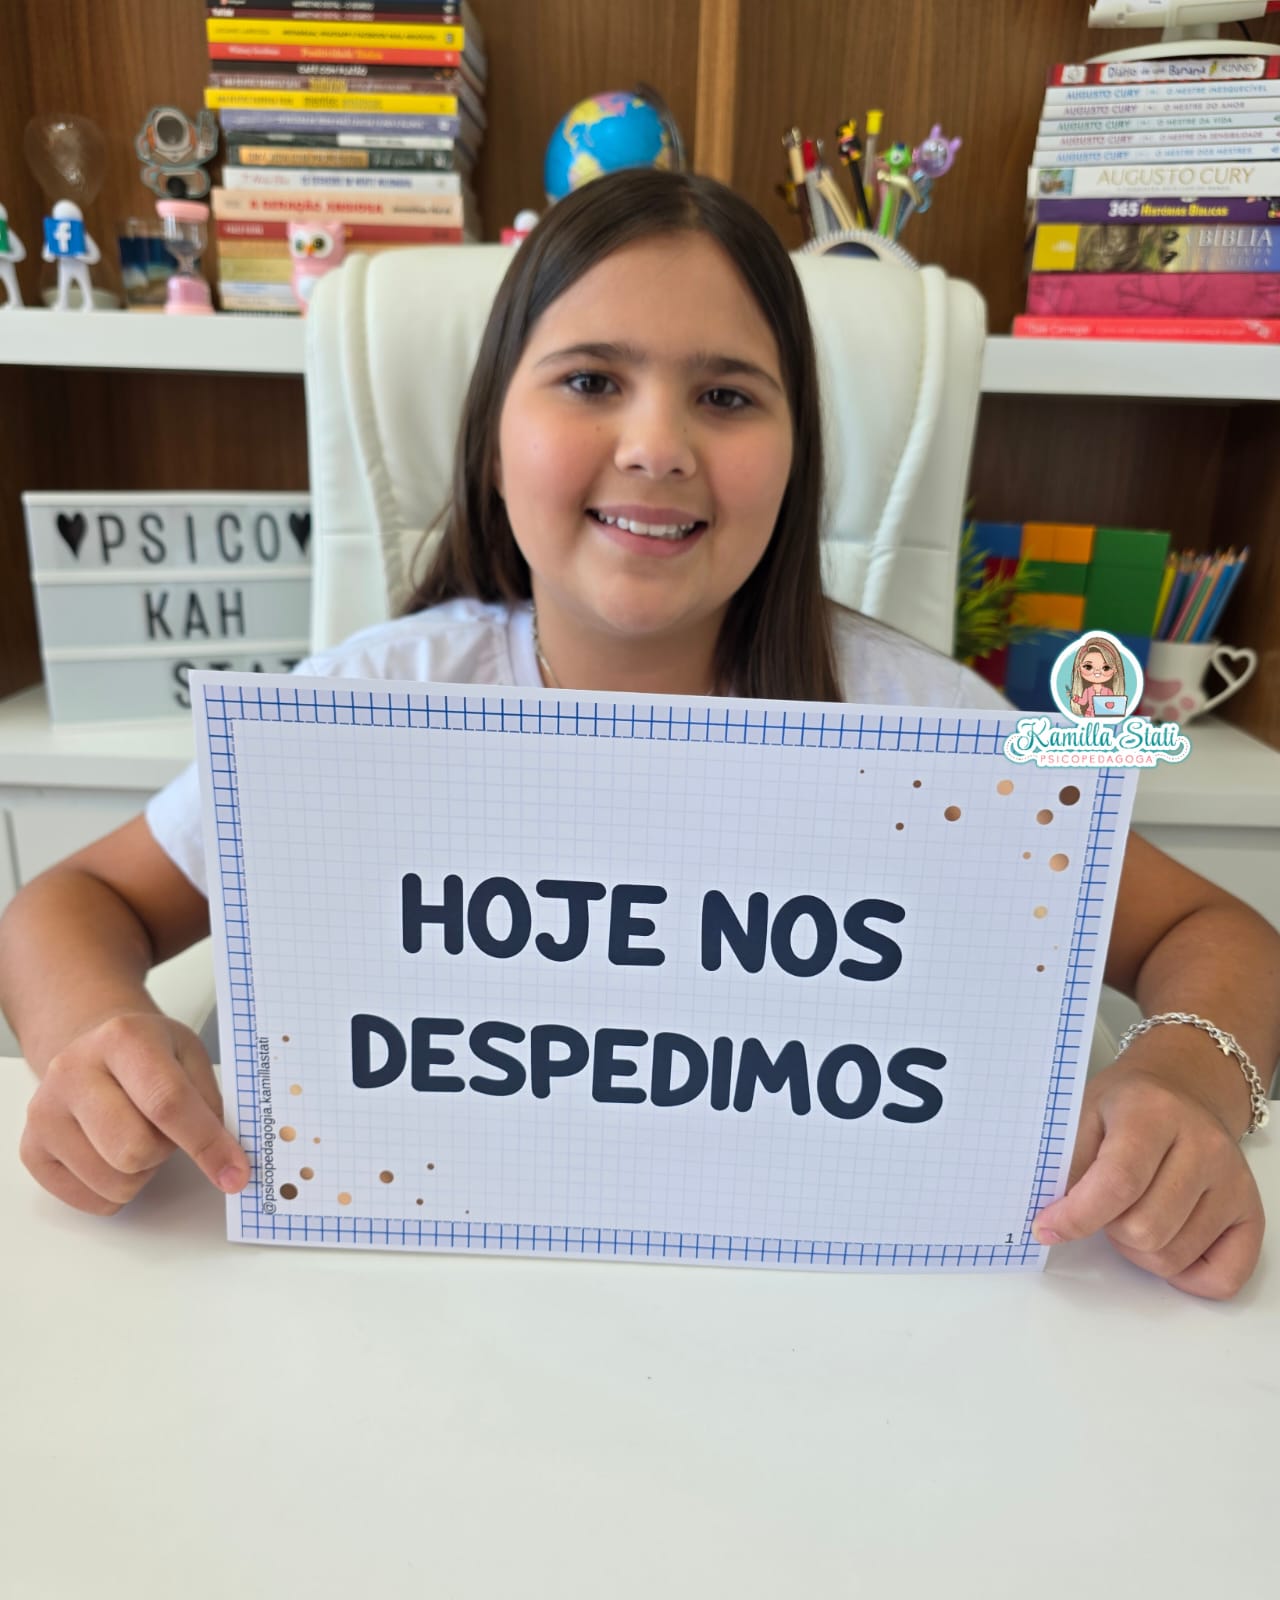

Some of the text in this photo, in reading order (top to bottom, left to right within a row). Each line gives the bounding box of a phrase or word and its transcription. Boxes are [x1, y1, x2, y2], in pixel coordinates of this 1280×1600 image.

[1168, 64, 1207, 76] Banana
[1220, 63, 1258, 73] KINNEY
[1066, 89, 1111, 100] AUGUSTO
[1114, 88, 1141, 98] CURY
[1064, 106, 1109, 116] AUGUSTO
[1112, 104, 1138, 114] CURY
[1057, 121, 1102, 131] AUGUSTO
[1105, 120, 1131, 130] CURY
[1060, 136, 1105, 146] AUGUSTO
[1108, 135, 1133, 144] CURY
[1056, 152, 1101, 162] AUGUSTO
[1104, 151, 1130, 160] CURY
[1096, 167, 1256, 186] AUGUSTO CURY
[1108, 200, 1140, 217] 365
[1198, 224, 1273, 247] BÍBLIA
[97, 512, 281, 565] PSICO
[144, 589, 246, 640] KAH
[402, 872, 906, 982] HOJE NOS
[351, 1013, 947, 1124] DESPEDIMOS
[258, 1036, 277, 1216] @psicopedagogia.kamillastati
[1004, 1232, 1014, 1244] 1
